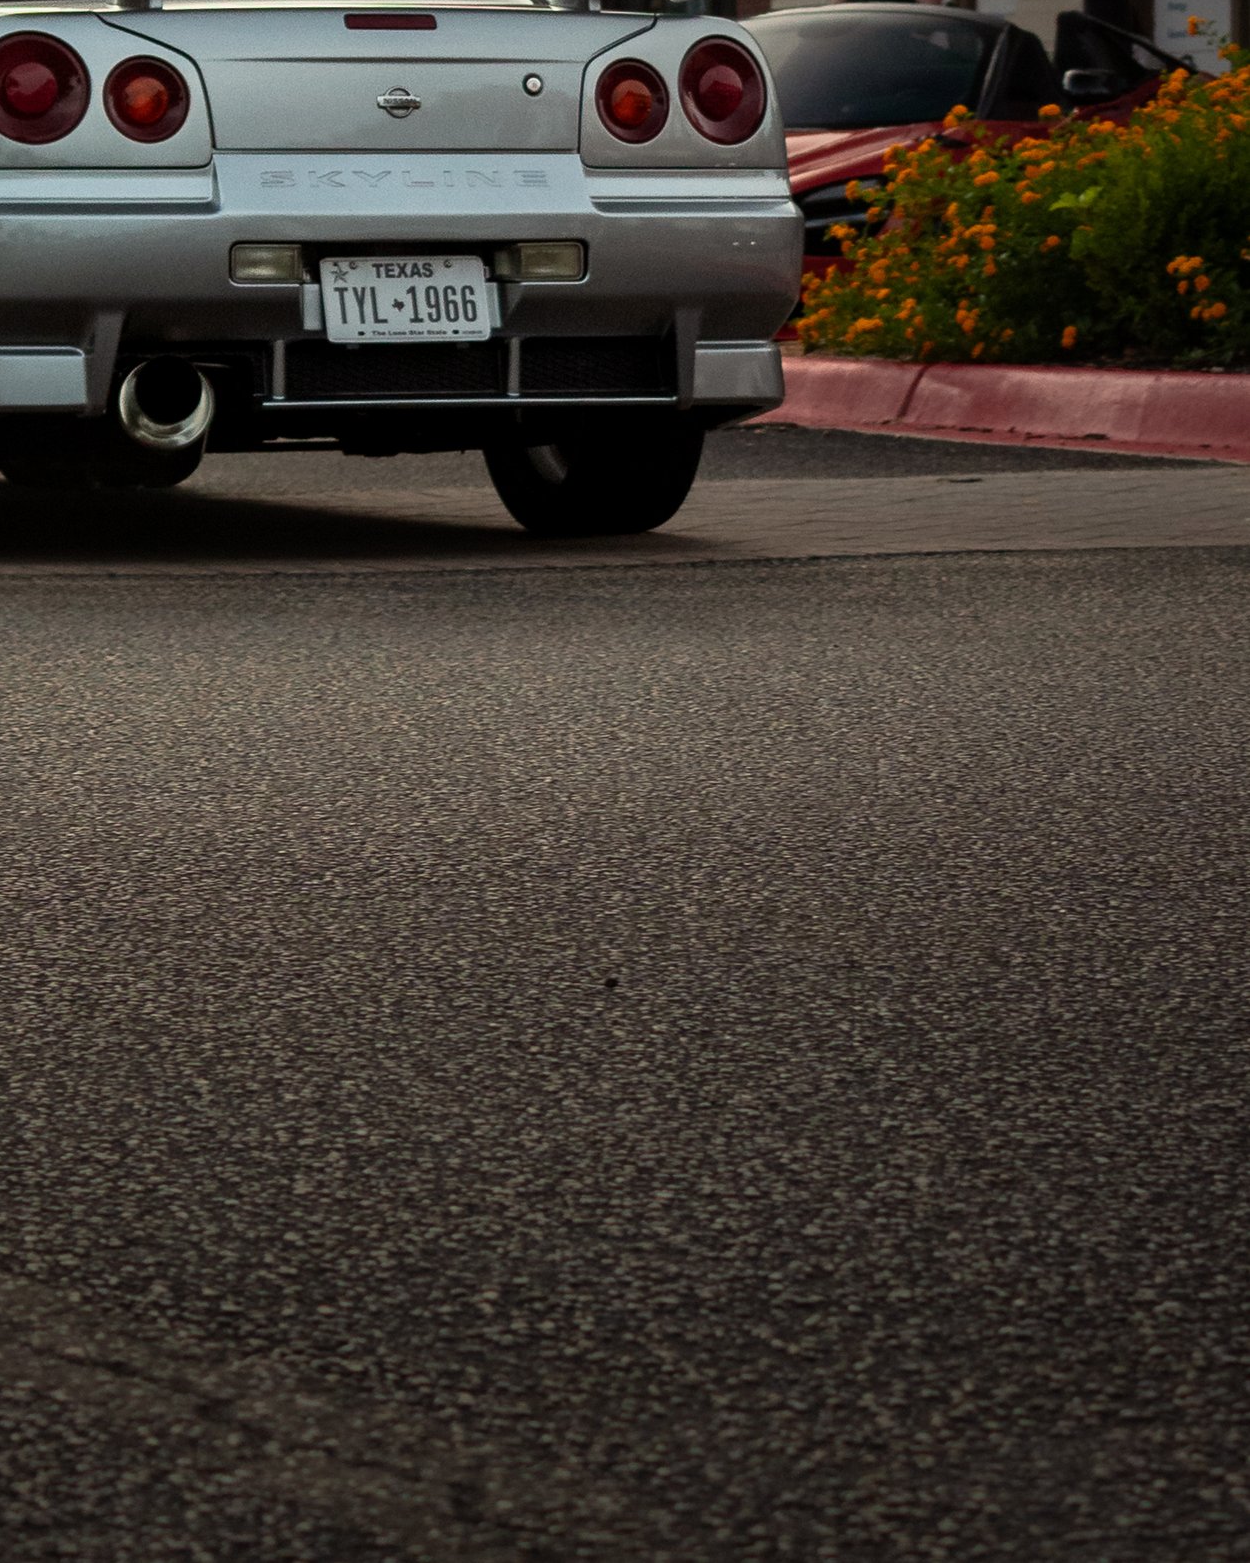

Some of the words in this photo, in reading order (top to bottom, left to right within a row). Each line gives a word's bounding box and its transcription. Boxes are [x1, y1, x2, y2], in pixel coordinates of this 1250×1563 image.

[259, 169, 549, 188] SKYLINE
[371, 262, 434, 278] TEXAS
[334, 286, 389, 324] TYL
[405, 285, 478, 323] 1966
